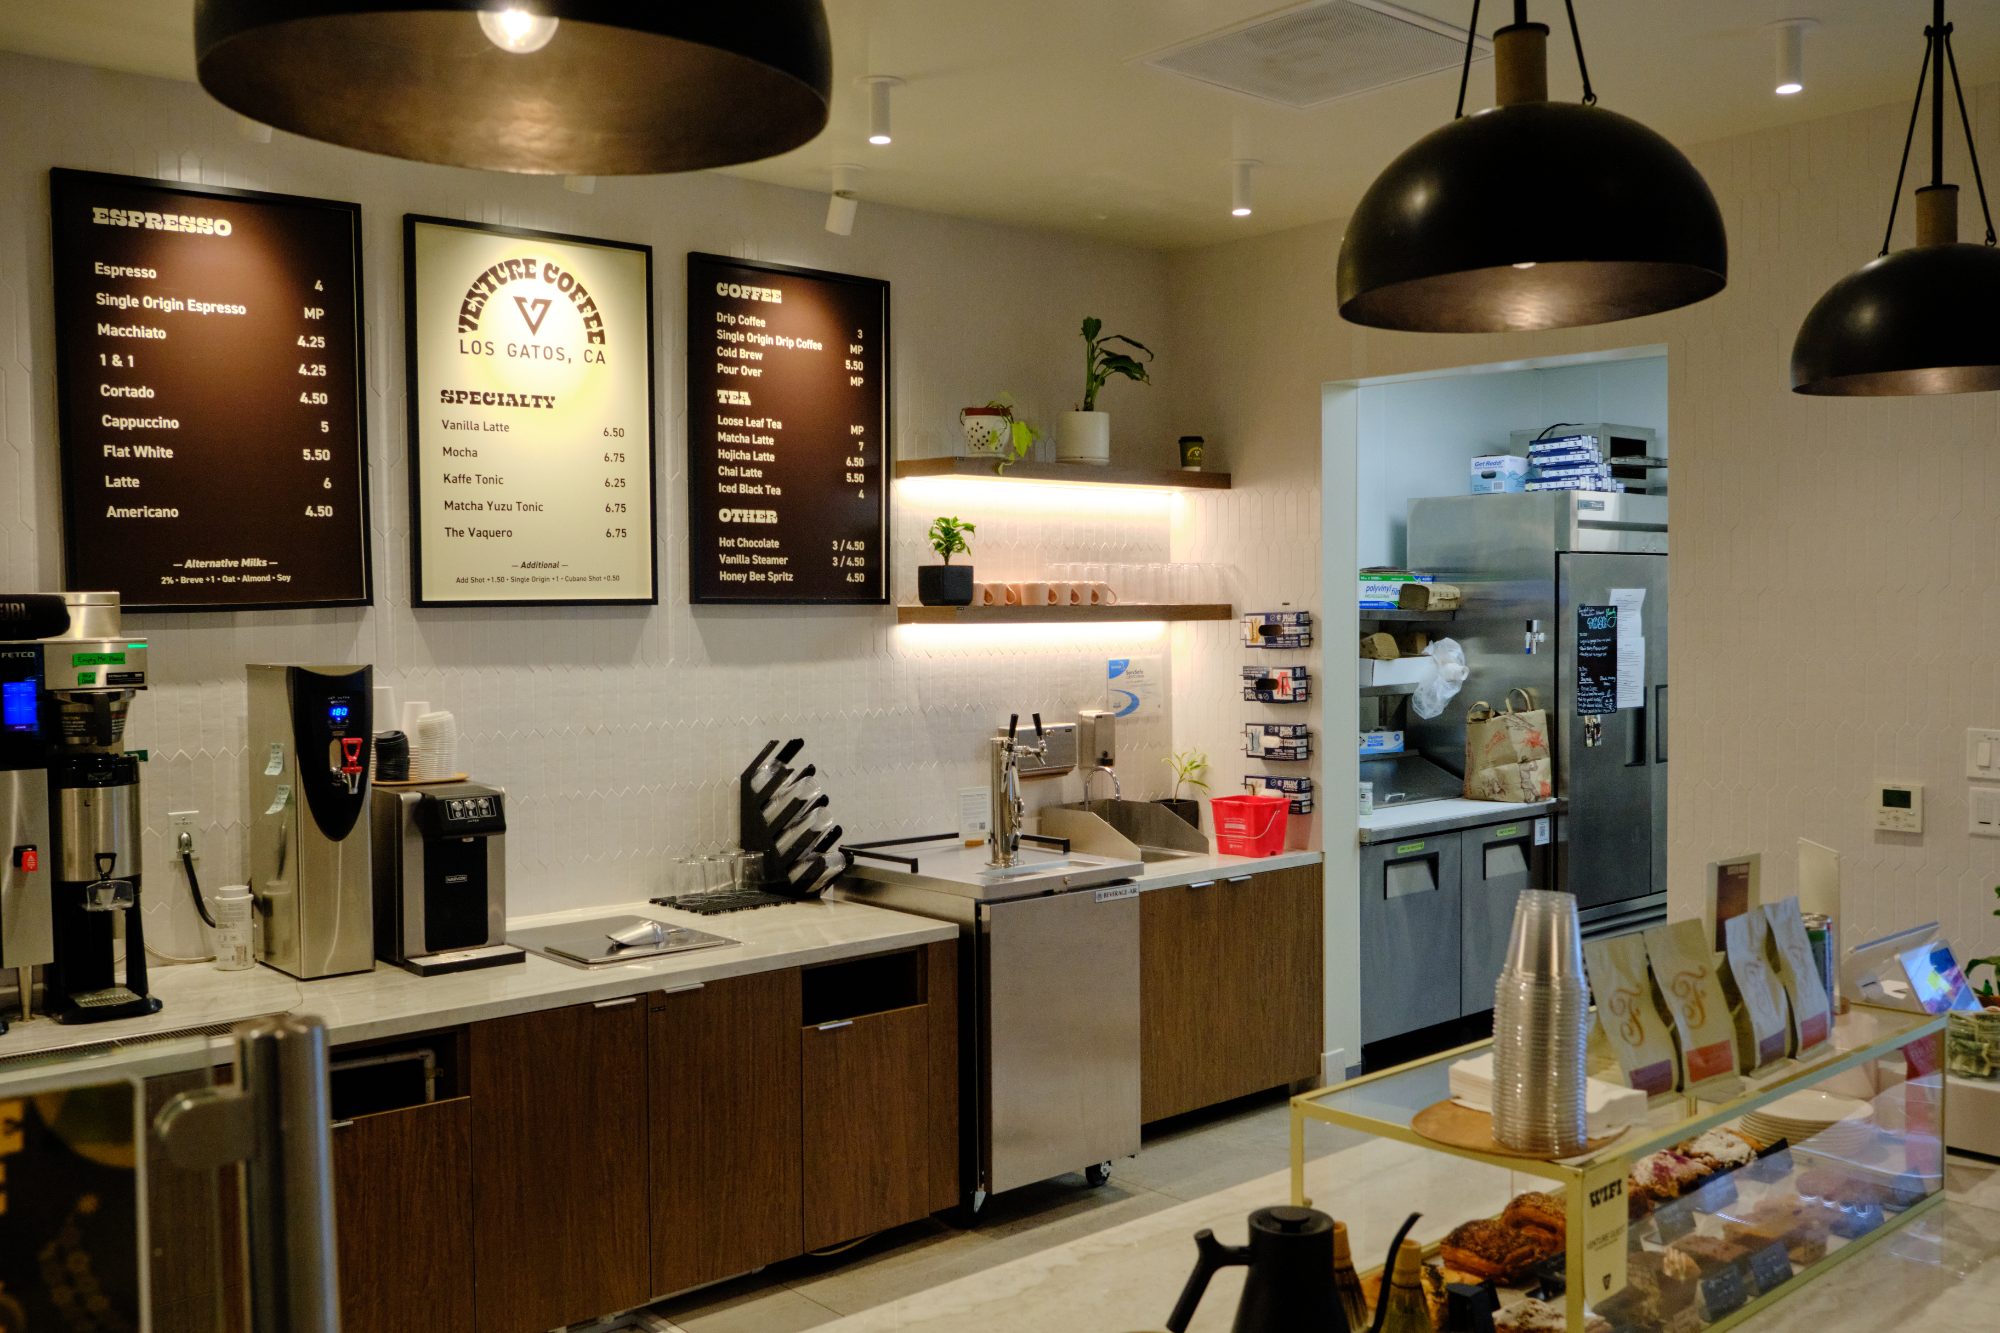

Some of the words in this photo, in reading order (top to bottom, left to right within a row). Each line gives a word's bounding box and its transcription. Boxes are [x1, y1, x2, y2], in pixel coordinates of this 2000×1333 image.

[93, 207, 231, 236] ESPRESSO
[95, 262, 156, 279] Espresso
[315, 280, 323, 291] 4
[716, 282, 782, 304] COFFEE
[96, 293, 139, 309] Single
[143, 296, 183, 313] Origin
[188, 299, 246, 315] Espresso
[458, 259, 537, 333] VENTURE
[543, 263, 606, 345] COFFEE
[304, 308, 324, 319] MP
[717, 312, 736, 326] Drip
[738, 315, 765, 327] Coffee
[98, 323, 166, 340] Macchiato
[858, 329, 862, 339] 3
[297, 336, 325, 348] 4.25
[717, 329, 744, 344] Single
[747, 333, 773, 347] Origin
[776, 336, 794, 349] Drip
[796, 338, 822, 350] Coffee
[460, 339, 495, 355] LOS
[507, 343, 572, 364] GATOS,
[584, 350, 606, 364] CA
[717, 346, 737, 358] Cold
[739, 348, 763, 360] Brew
[850, 344, 863, 355] MP
[100, 354, 105, 366] 1
[112, 355, 123, 367] &
[128, 356, 133, 367] 1
[845, 360, 863, 370] 5.50
[299, 365, 326, 376] 4.25
[717, 363, 739, 374] Pour
[741, 366, 762, 377] Over
[850, 377, 863, 387] MP
[100, 385, 154, 398] Cortado
[300, 393, 328, 404] 4.50
[441, 390, 555, 409] SPECIALTY
[717, 390, 751, 405] TEA
[102, 415, 179, 430] Cappuccino
[321, 421, 329, 432] 5
[442, 420, 479, 431] Vanilla
[483, 422, 510, 432] Latte
[718, 415, 743, 427] Loose
[746, 417, 764, 428] Leaf
[766, 419, 782, 429] Tea
[603, 428, 624, 437] 6.50
[851, 425, 864, 435] MP
[718, 432, 749, 444] Matcha
[752, 435, 774, 445] Latte
[103, 445, 130, 458] Flat
[133, 446, 173, 459] White
[443, 447, 478, 457] Mocha
[859, 442, 864, 451] 7
[303, 449, 330, 461] 5.50
[604, 453, 625, 462] 6.75
[718, 449, 750, 462] Hojicha
[753, 452, 775, 462] Latte
[846, 458, 864, 467] 6.50
[718, 466, 737, 477] Chai
[741, 468, 762, 478] Latte
[105, 476, 139, 488] Latte
[323, 478, 331, 489] 6
[443, 474, 471, 484] Kaffe
[475, 474, 503, 485] Tonic
[605, 479, 625, 487] 6.25
[847, 474, 864, 483] 5.50
[719, 483, 737, 493] Iced
[739, 484, 763, 494] Black
[765, 485, 781, 495] Tea
[859, 490, 864, 499] 4
[305, 506, 333, 517] 4.50
[444, 501, 483, 511] Matcha
[487, 501, 512, 511] Yuzu
[516, 502, 543, 511] Tonic
[605, 504, 626, 512] 6.75
[106, 506, 178, 518] Americano
[719, 508, 777, 524] OTHER
[445, 528, 464, 537] The
[468, 528, 512, 539] Vaquero
[606, 529, 626, 538] 6.75
[719, 538, 735, 548] Hot
[737, 538, 779, 548] Chocolate
[833, 541, 838, 550] 3
[847, 541, 864, 550] 4.50
[185, 559, 238, 569] Alternative
[241, 558, 267, 567] Milks
[719, 554, 750, 564] Vanilla
[752, 555, 788, 564] Steamer
[833, 557, 838, 566] 3
[847, 557, 864, 566] 4.50
[521, 561, 559, 569] Additional
[161, 576, 174, 585] 2%
[181, 576, 204, 584] Breve
[222, 575, 235, 583] Oat
[242, 574, 270, 583] Almond
[277, 574, 291, 583] Soy
[532, 575, 550, 583] Origin
[720, 572, 747, 583] Honey
[750, 572, 765, 581] Bee
[768, 572, 793, 582] Spritz
[847, 573, 864, 582] 4.50
[1366, 584, 1391, 593] polyvinyl
[1, 651, 36, 659] FETCO
[332, 707, 348, 716] 180
[1589, 1179, 1622, 1208] WIFI
